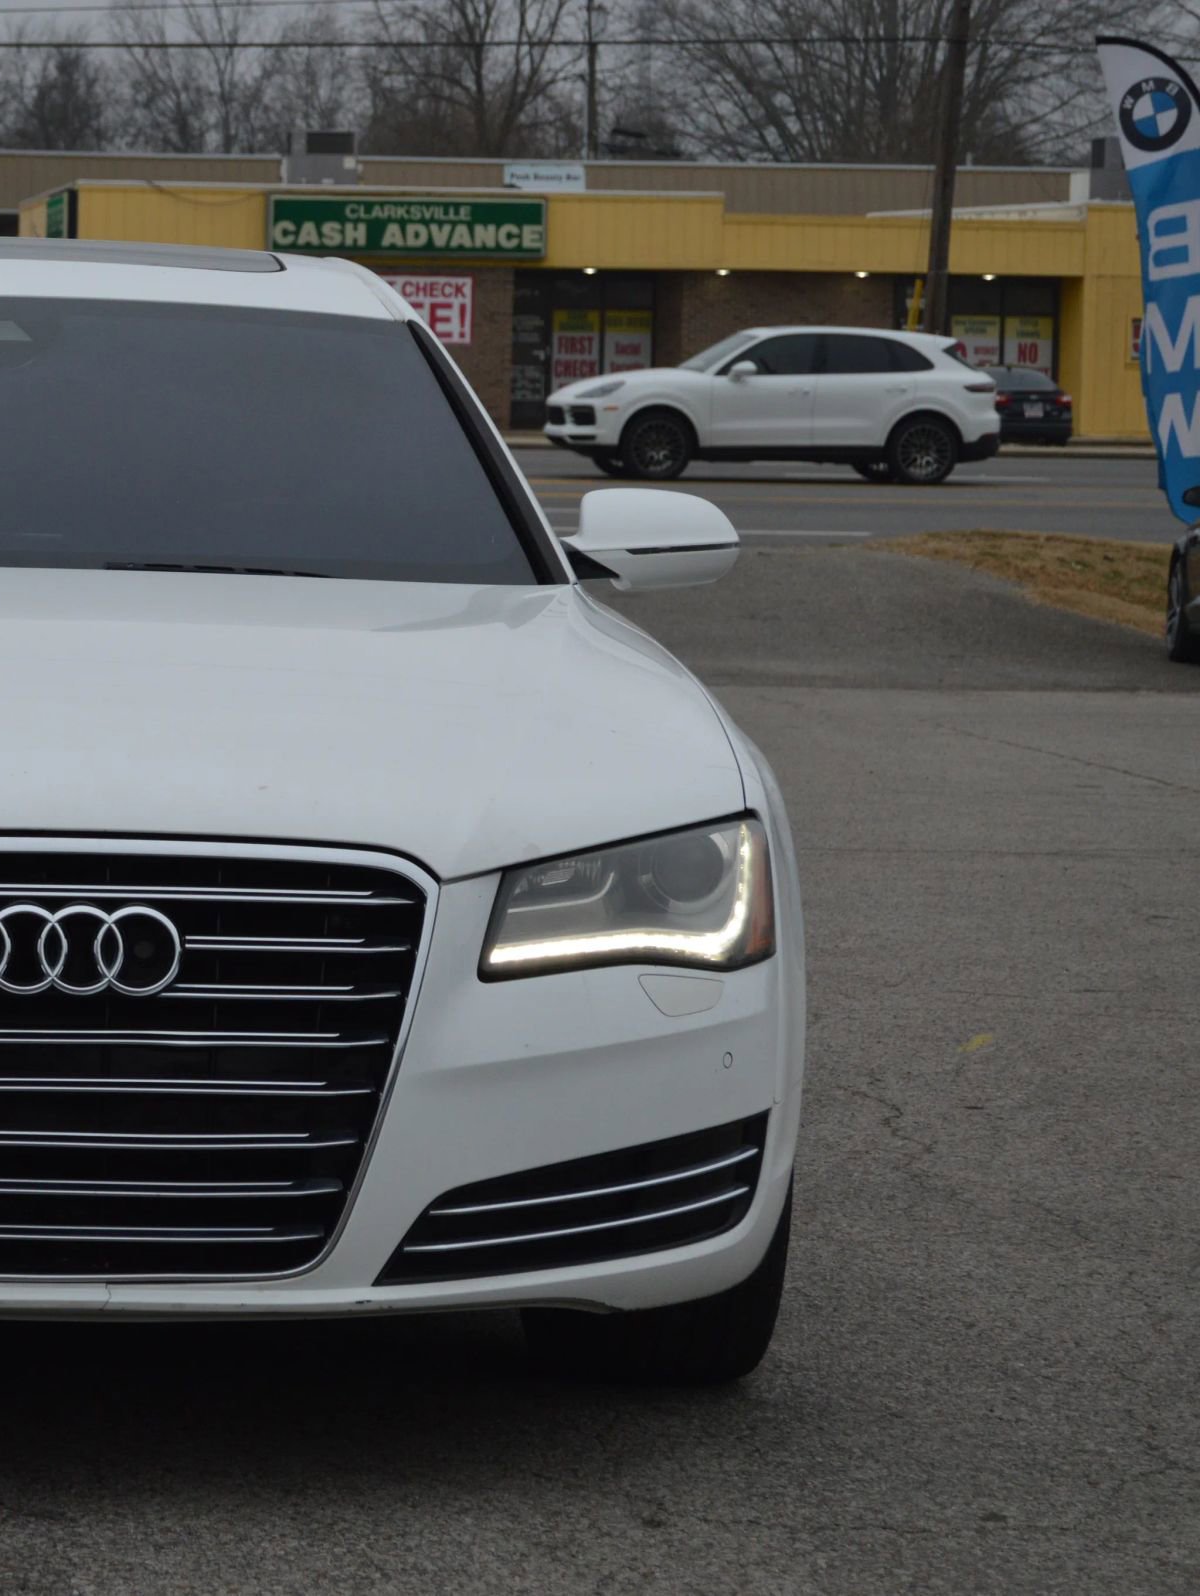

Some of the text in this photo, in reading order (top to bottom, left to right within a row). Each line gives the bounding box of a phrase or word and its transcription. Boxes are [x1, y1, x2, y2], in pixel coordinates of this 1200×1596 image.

[345, 204, 471, 222] CLARKSVILLE
[273, 220, 543, 249] CASH ADVANCE
[401, 280, 466, 298] CHECK
[557, 335, 594, 356] FIRST
[1017, 341, 1039, 364] NO
[554, 360, 597, 378] CHECK
